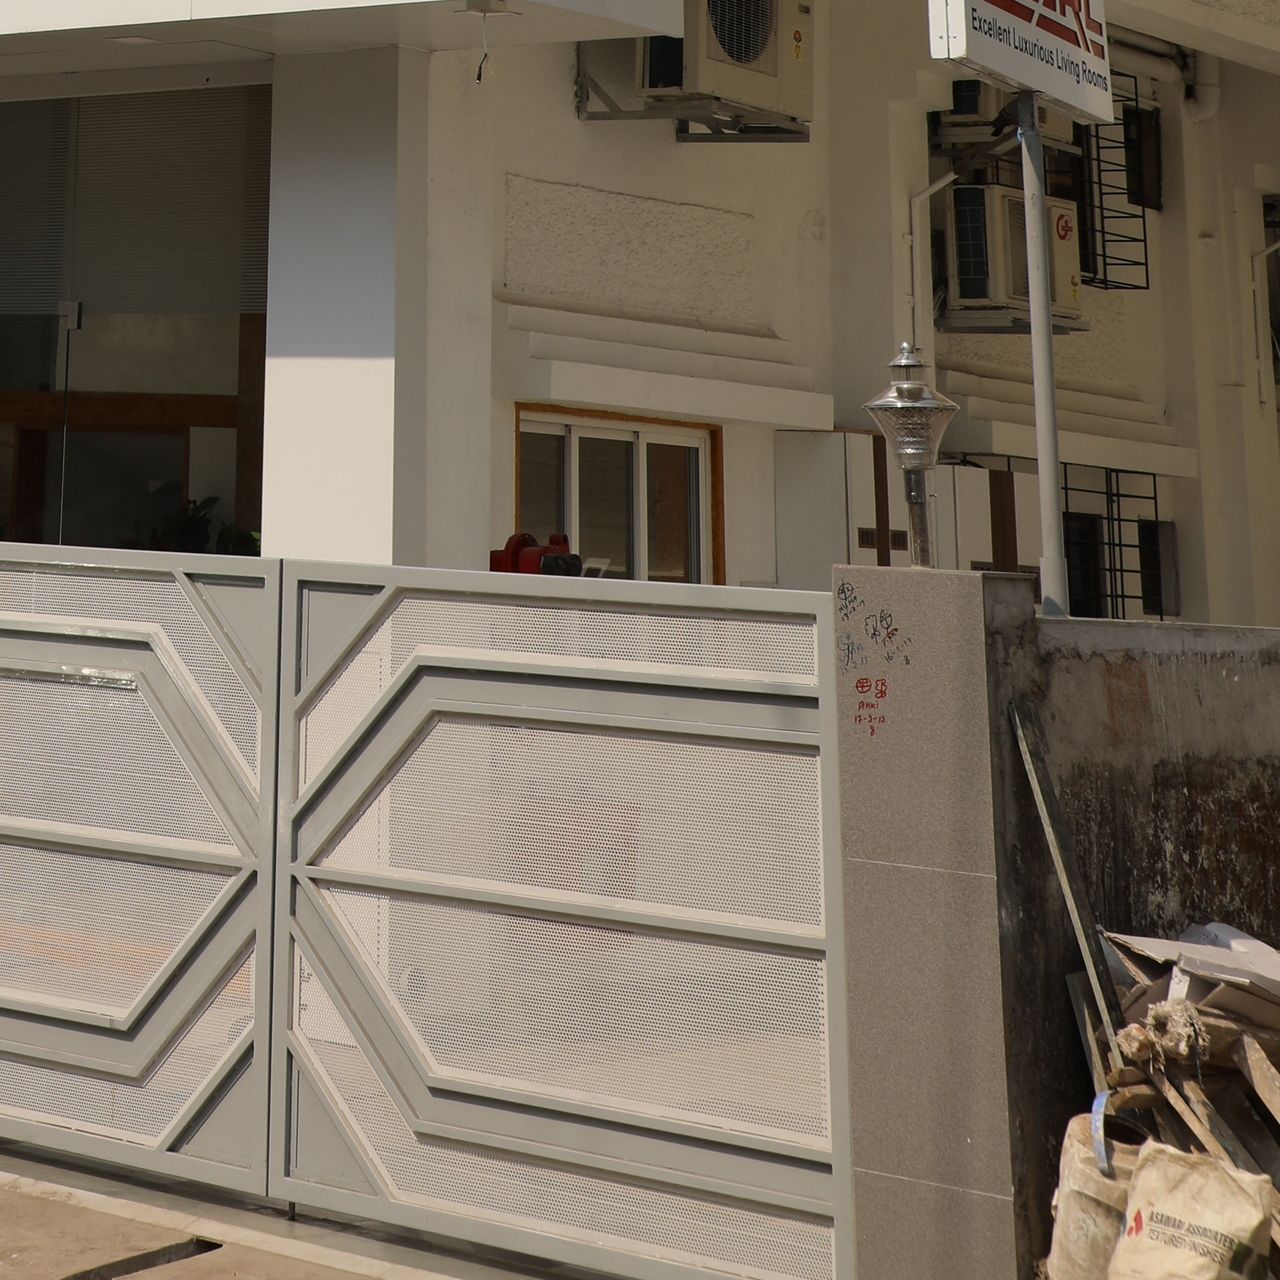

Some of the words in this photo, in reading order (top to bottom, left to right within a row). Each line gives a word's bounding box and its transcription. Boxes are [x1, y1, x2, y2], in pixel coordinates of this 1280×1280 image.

[971, 7, 1012, 46] Excellent
[1012, 27, 1055, 67] Luxurious
[1055, 48, 1081, 84] Living
[1081, 60, 1108, 92] Rooms
